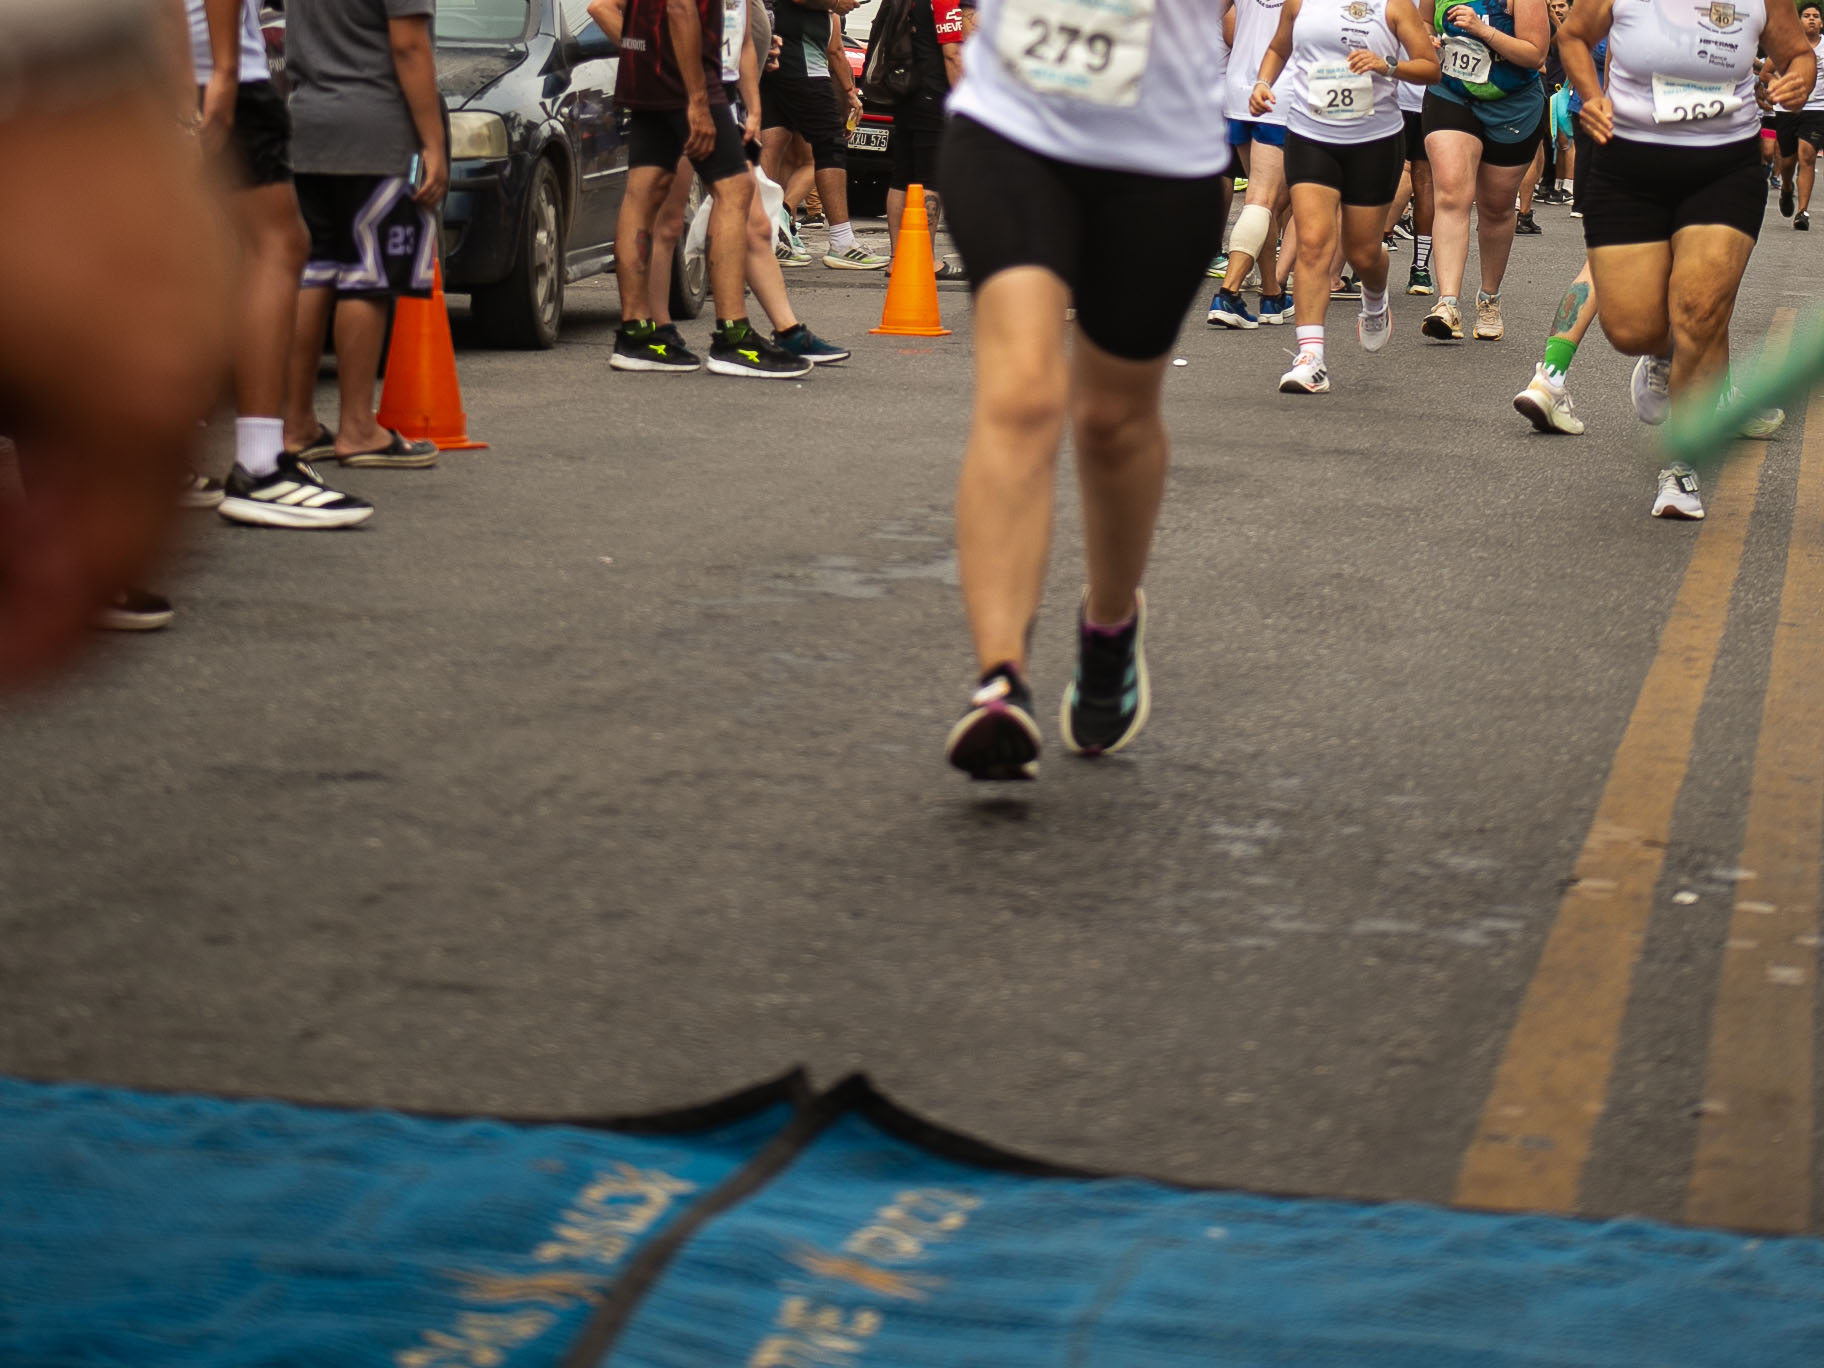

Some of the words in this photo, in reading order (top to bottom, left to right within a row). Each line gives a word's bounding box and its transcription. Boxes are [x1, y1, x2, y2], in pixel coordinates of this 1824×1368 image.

[1352, 9, 1363, 18] 40
[1714, 16, 1730, 26] 40
[1023, 18, 1113, 73] 279
[1451, 51, 1482, 73] 197
[1326, 88, 1354, 108] 28
[870, 134, 887, 147] 575
[387, 225, 415, 255] 23
